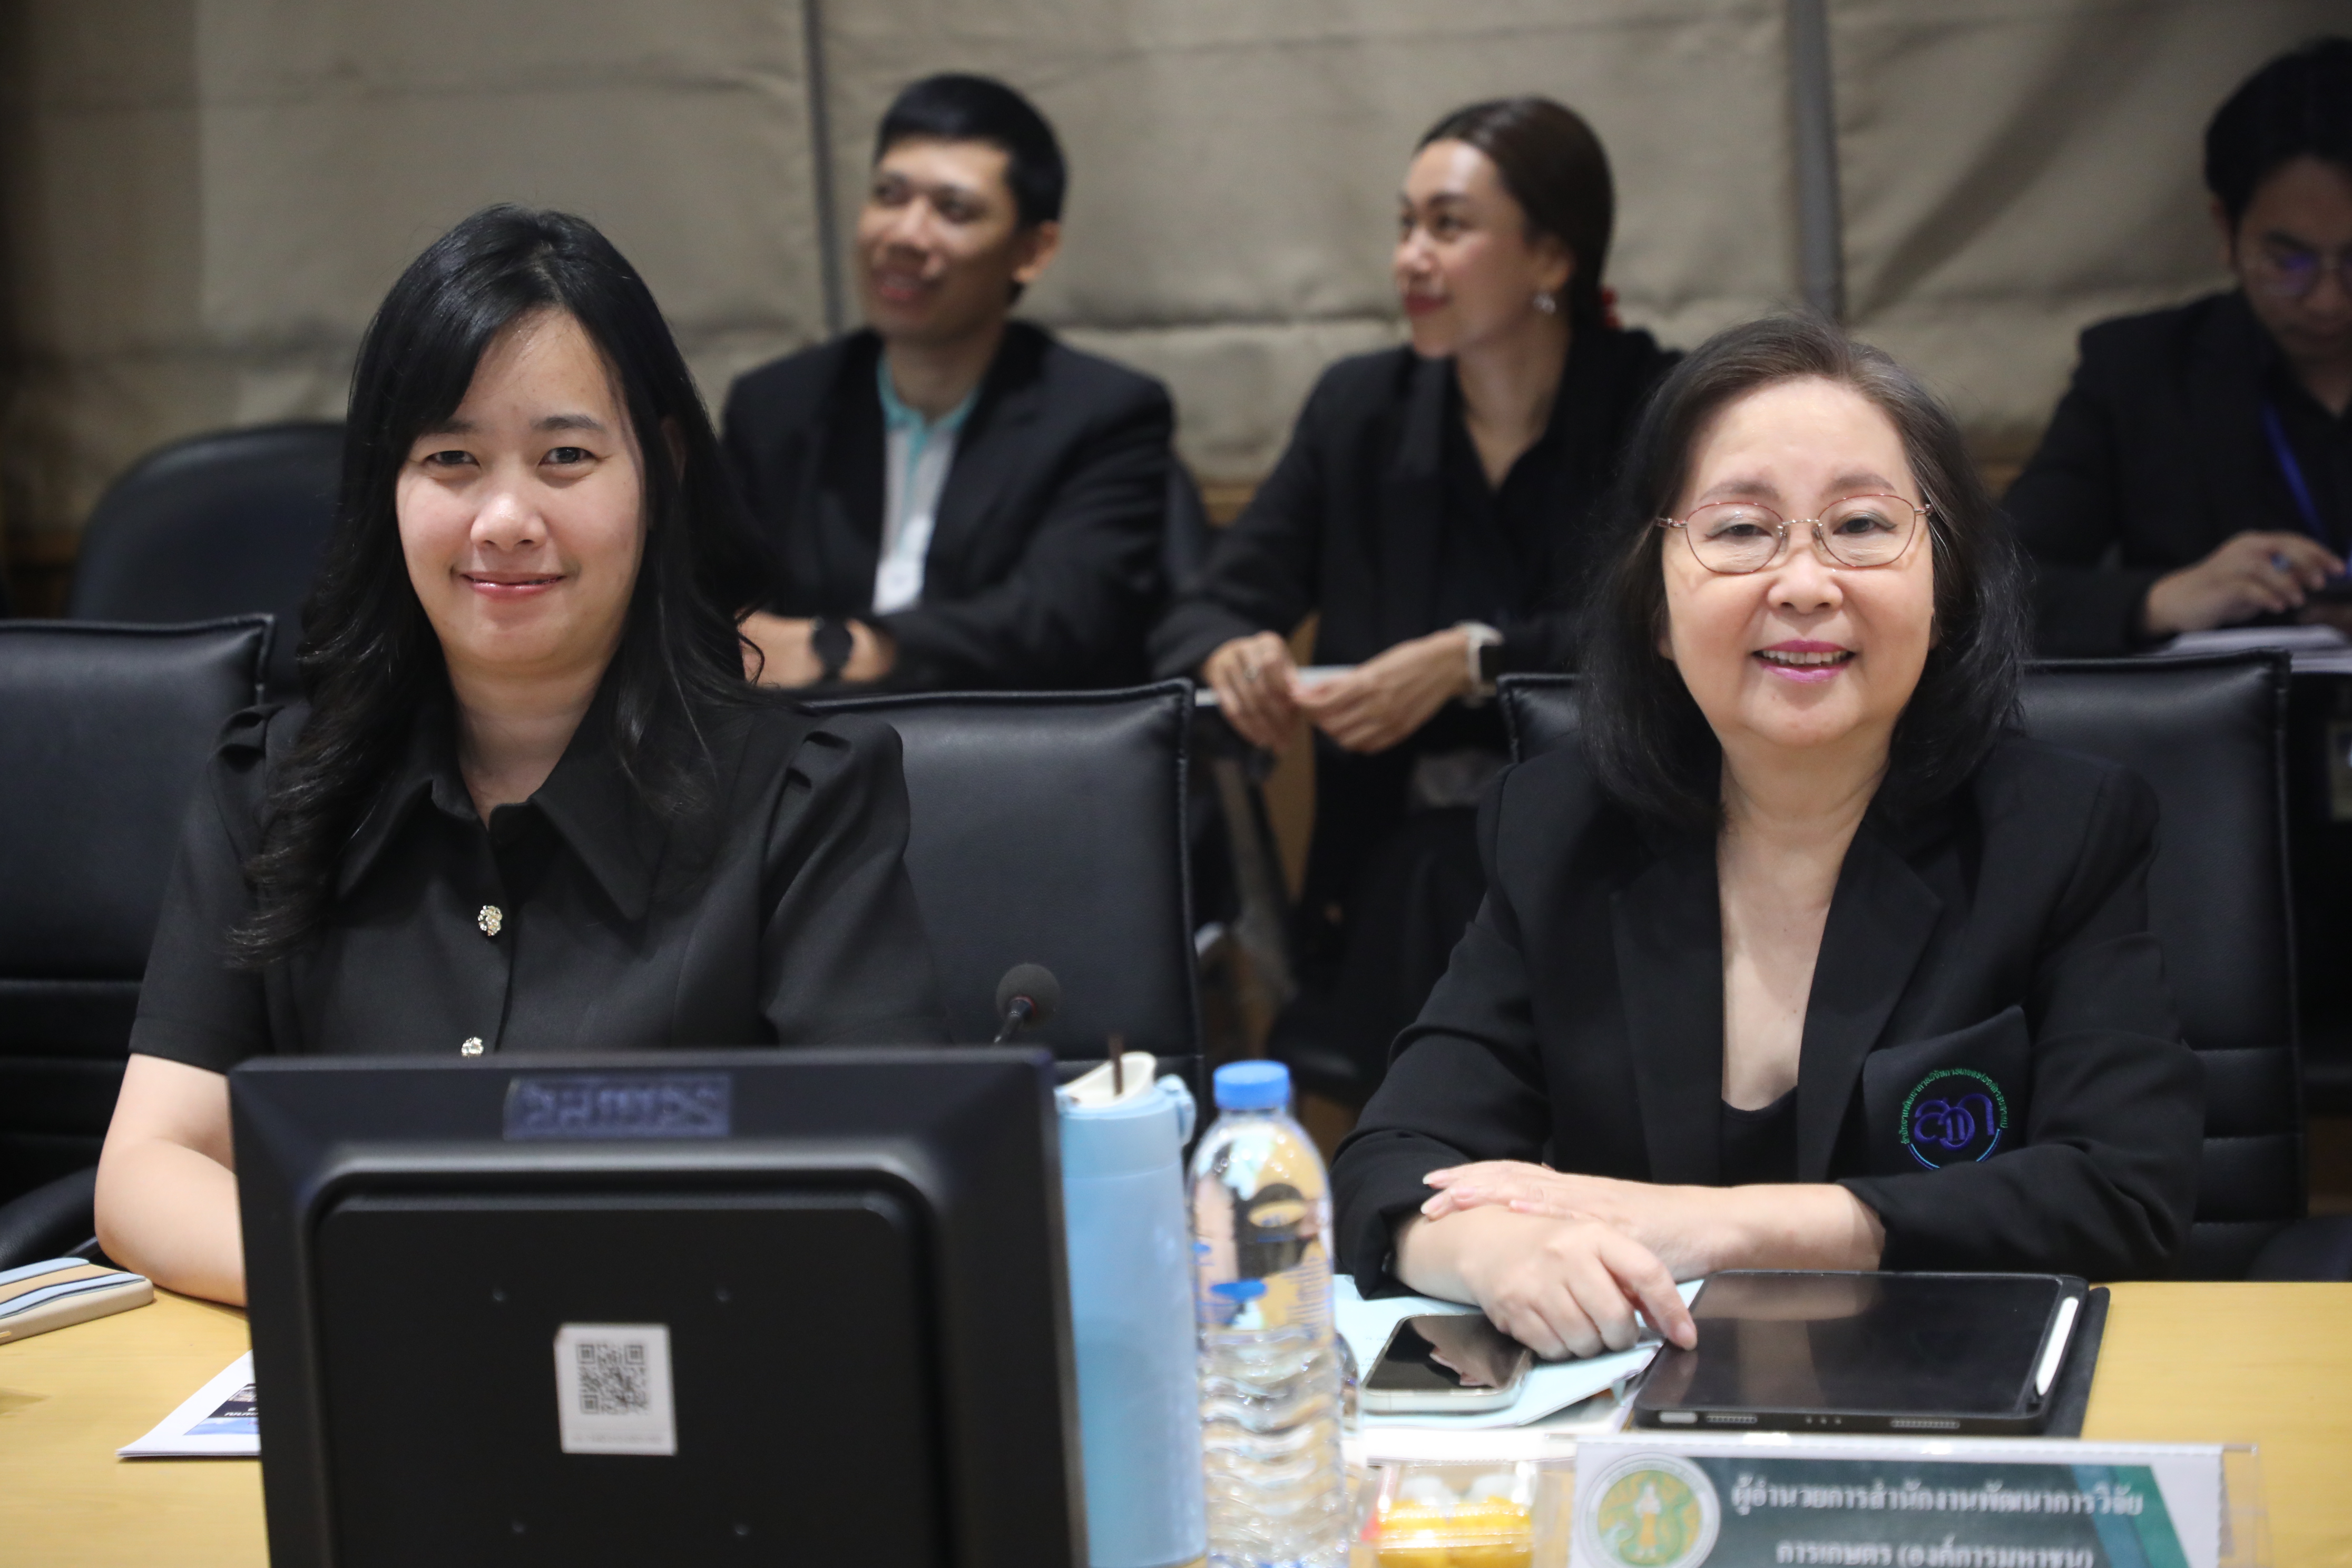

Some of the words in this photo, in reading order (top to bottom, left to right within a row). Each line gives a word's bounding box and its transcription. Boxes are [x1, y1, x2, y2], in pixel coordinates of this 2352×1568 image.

[1730, 1472, 2144, 1515] ผู้อำนวยการสำนักงานพัฒนาการวิจัย
